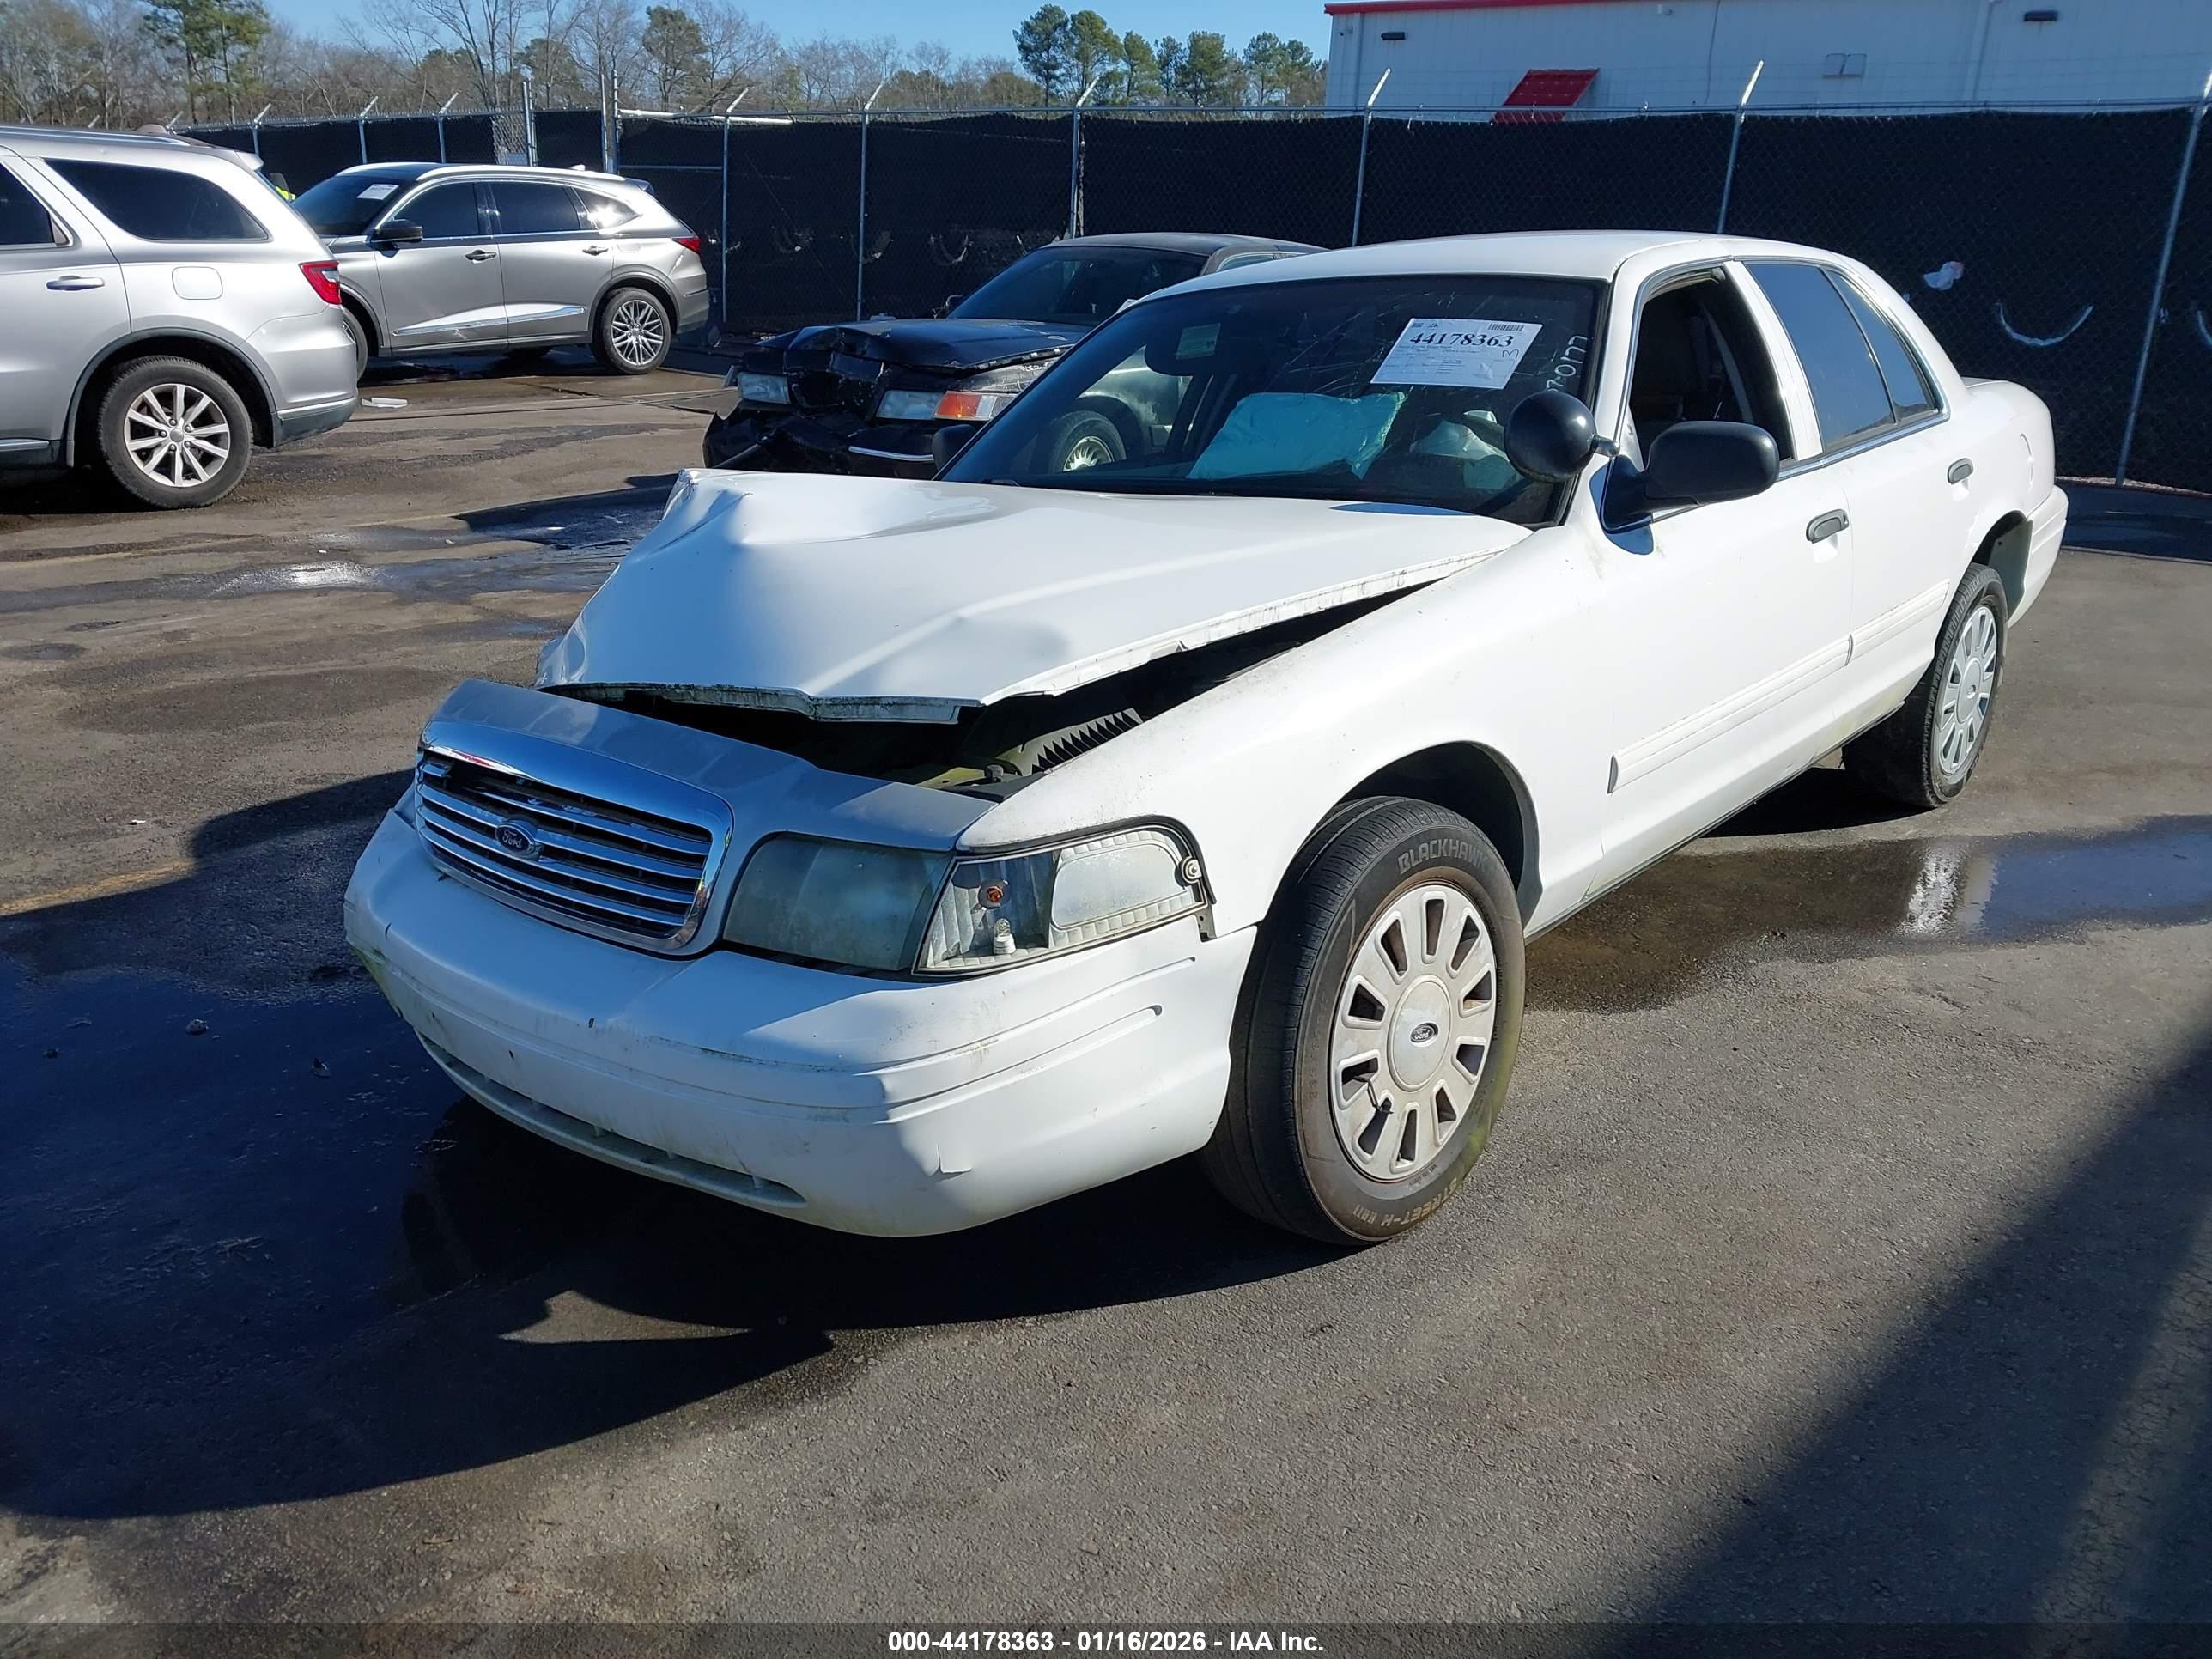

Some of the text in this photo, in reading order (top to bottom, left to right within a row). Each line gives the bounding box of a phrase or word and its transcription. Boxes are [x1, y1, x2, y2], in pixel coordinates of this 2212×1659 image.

[1409, 332, 1515, 347] 44178363
[1547, 335, 1589, 392] 7-0177
[1397, 838, 1487, 874] BLACKHAWK
